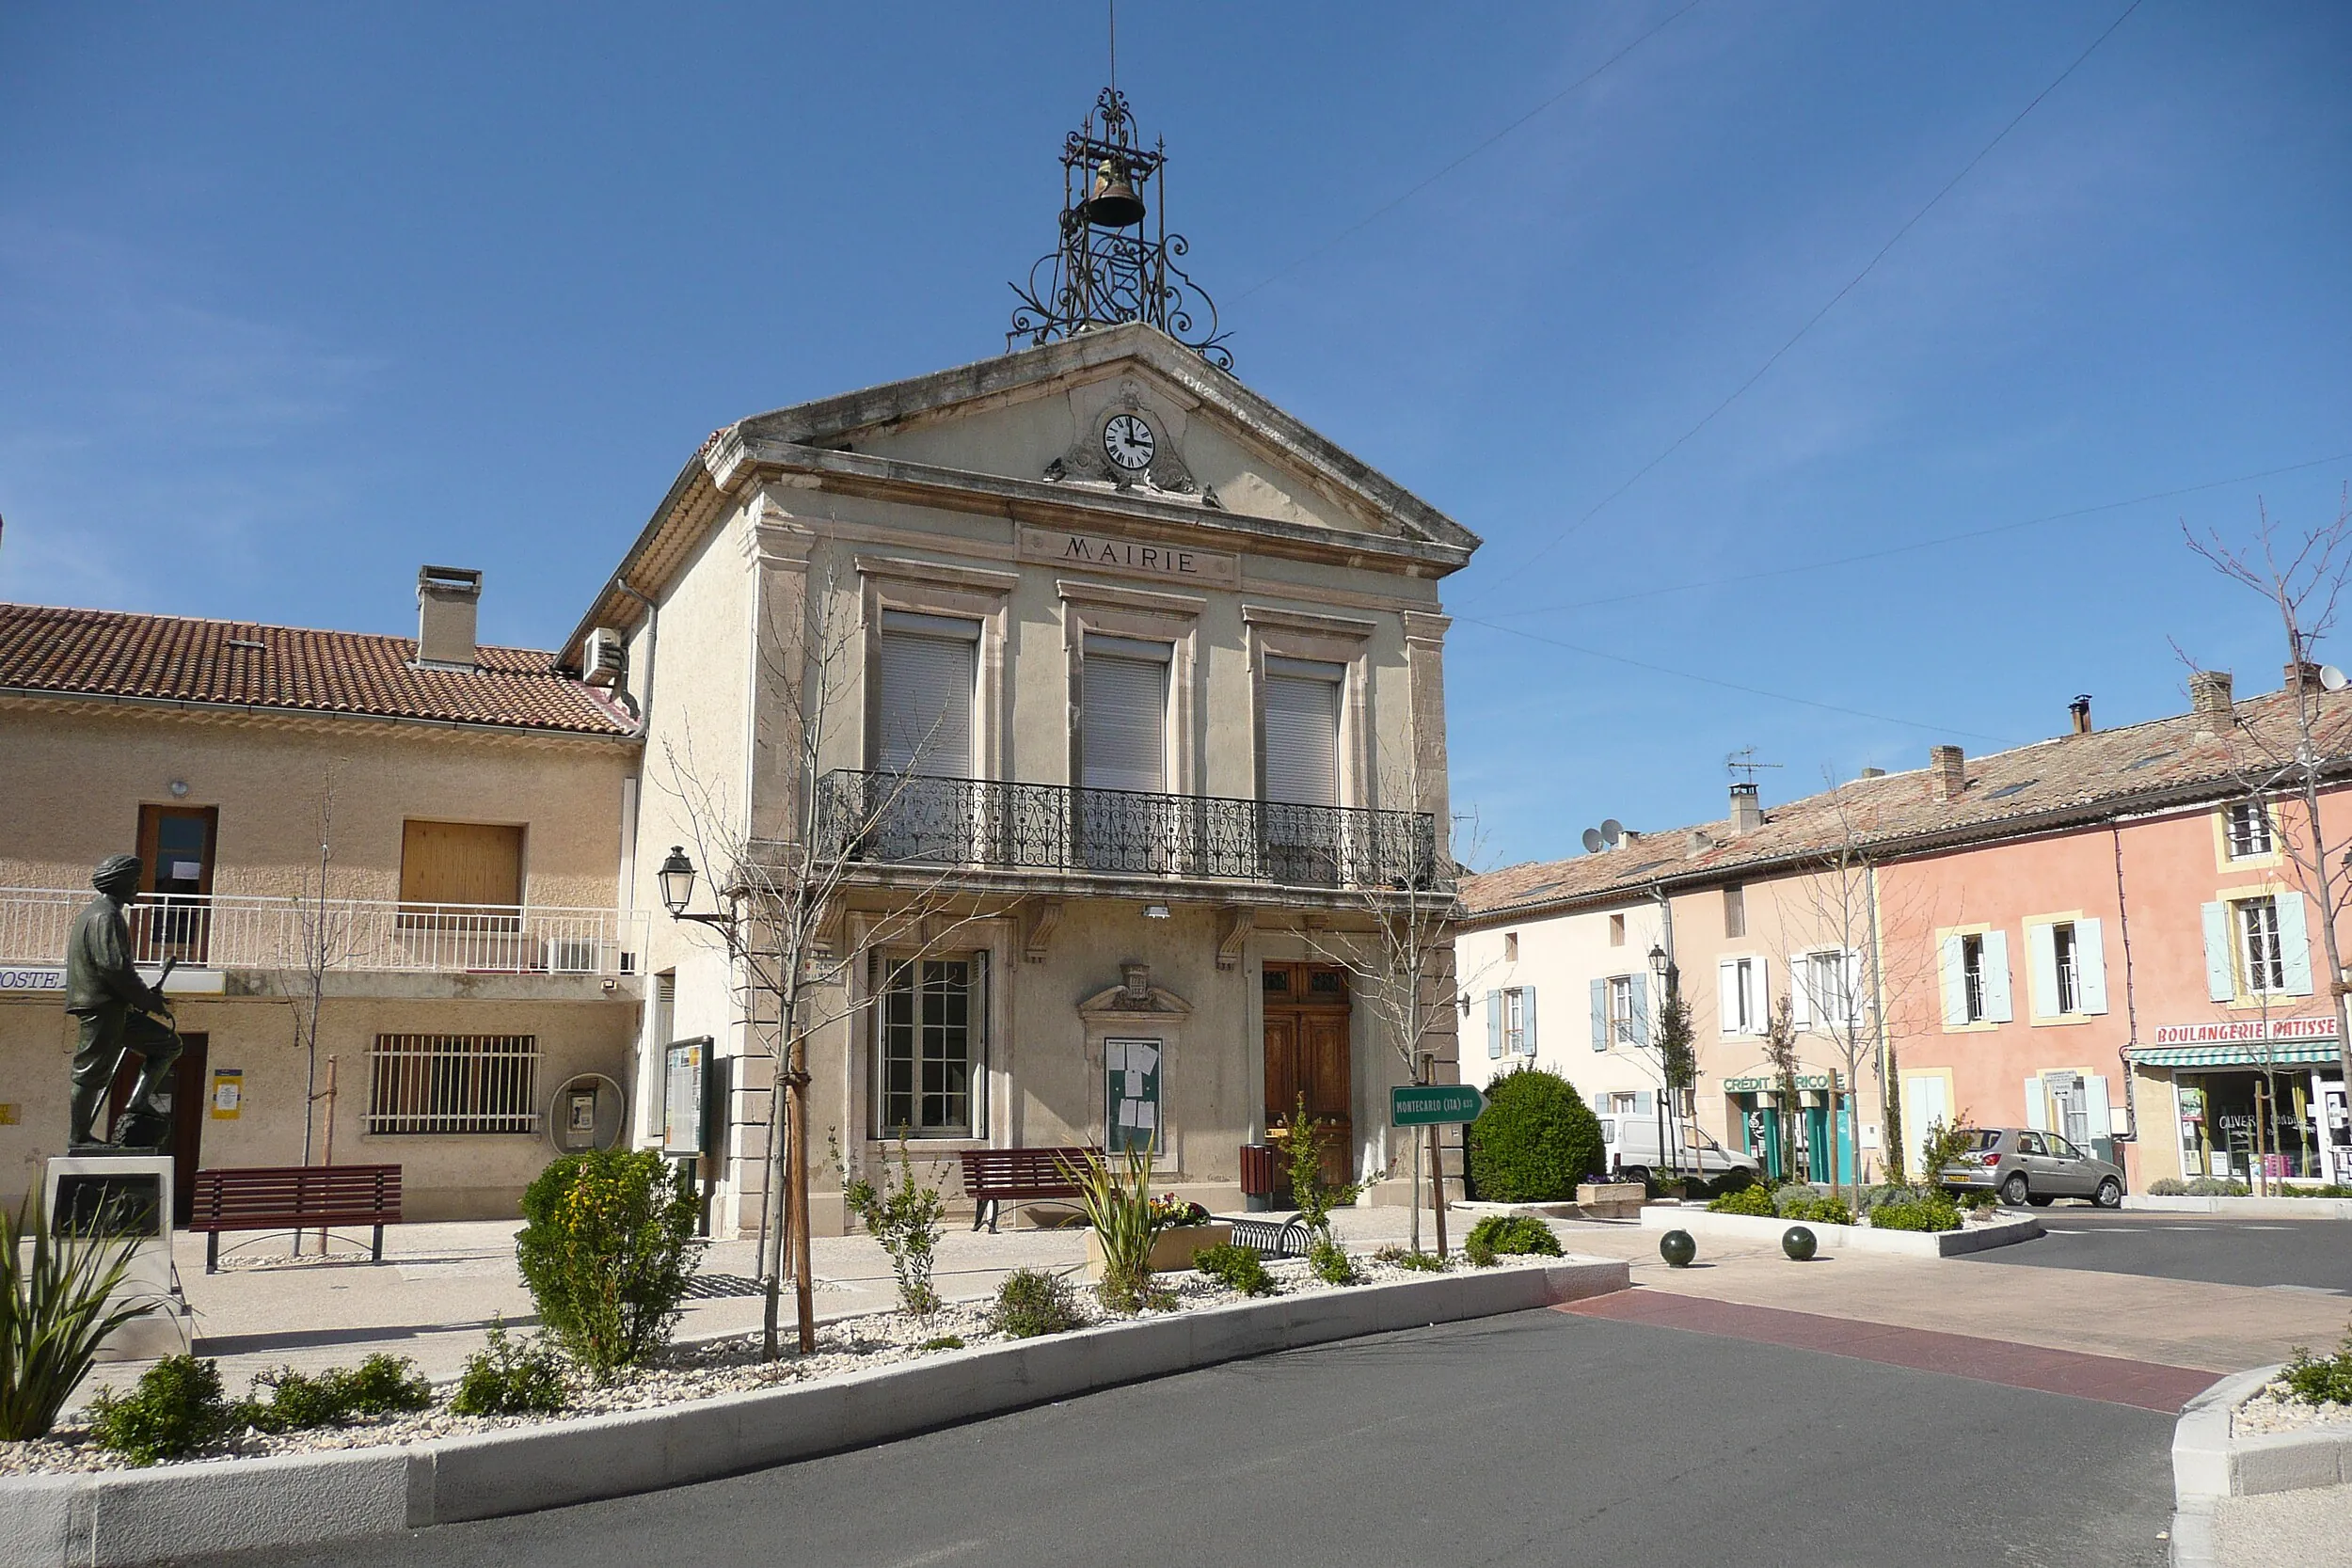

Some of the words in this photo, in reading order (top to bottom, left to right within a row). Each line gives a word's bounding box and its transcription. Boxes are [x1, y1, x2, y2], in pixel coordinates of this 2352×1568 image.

[1065, 537, 1197, 573] MAIRIE
[0, 971, 60, 989] OSTE
[2157, 1023, 2264, 1043] BOULANGERIE
[2272, 1019, 2335, 1037] PATISSE
[1724, 1075, 1771, 1090] CRÉDIT
[1396, 1099, 1441, 1114] MONTECARLO
[1443, 1097, 1461, 1112] (ITA)
[2219, 1114, 2257, 1129] OUVER
